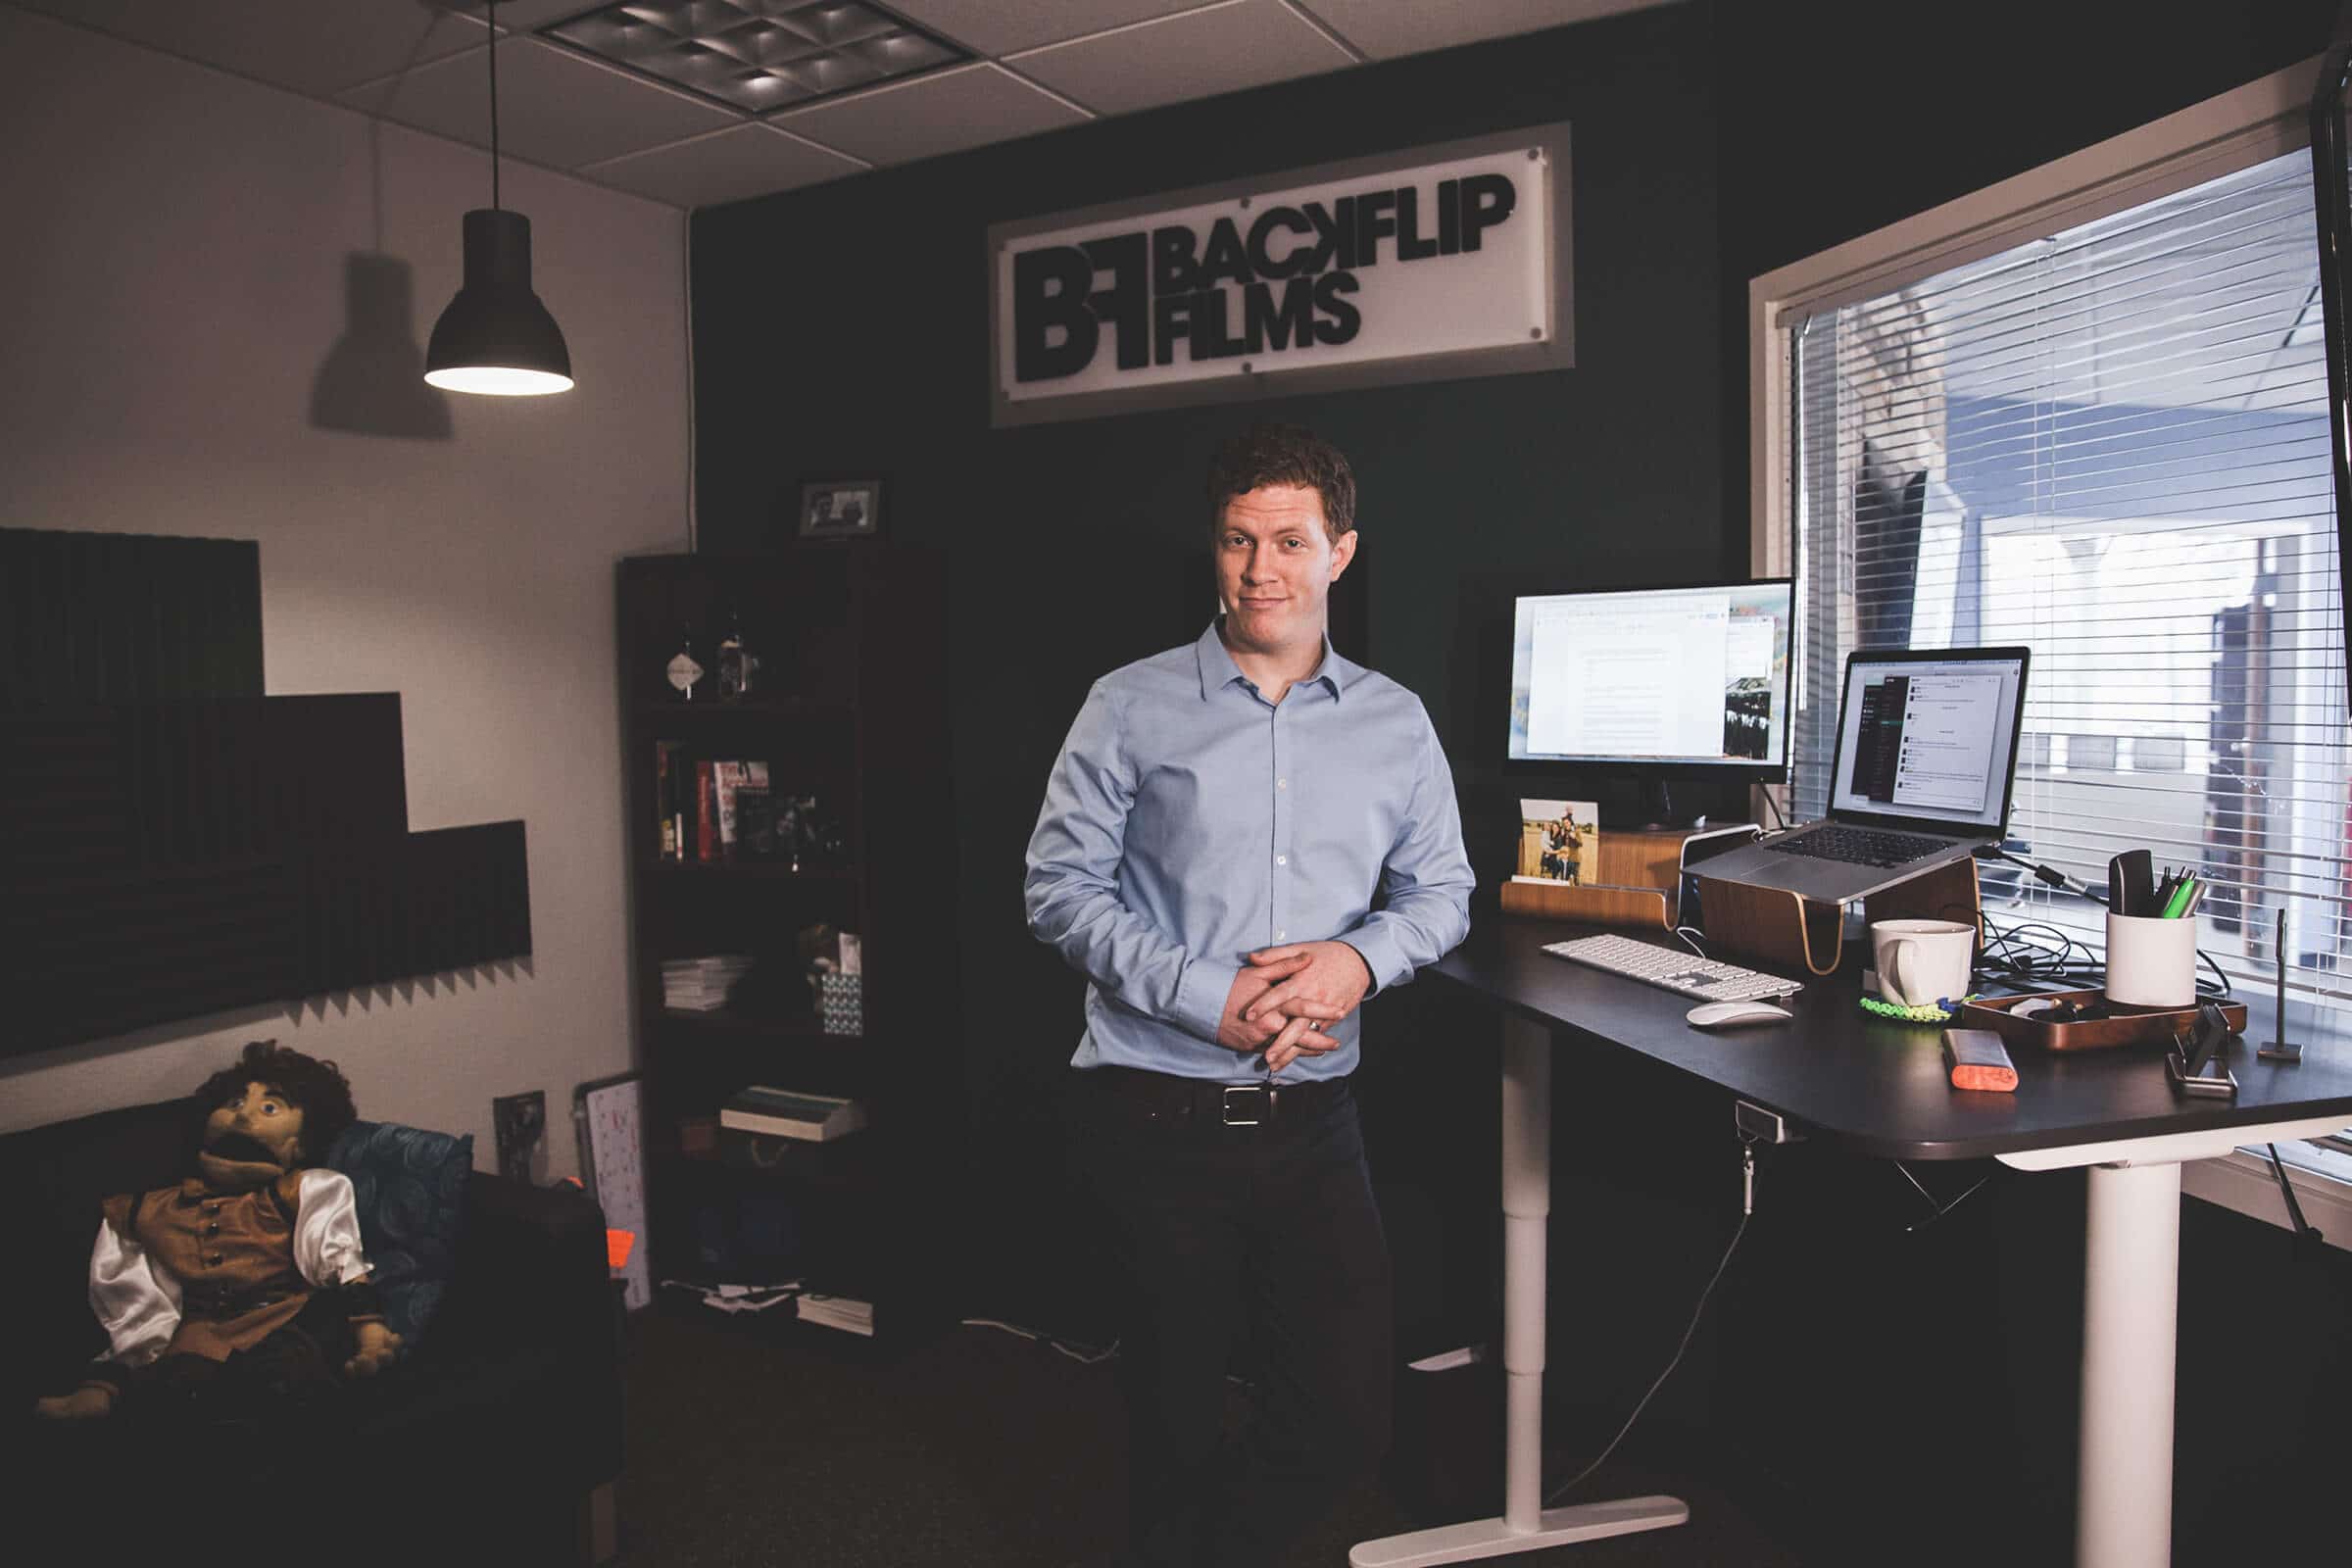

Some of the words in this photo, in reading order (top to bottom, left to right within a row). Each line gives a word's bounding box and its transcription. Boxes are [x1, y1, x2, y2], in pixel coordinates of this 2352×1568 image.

[1152, 172, 1517, 290] BACKFLIP
[1013, 232, 1150, 383] BF
[1154, 270, 1362, 366] FILMS
